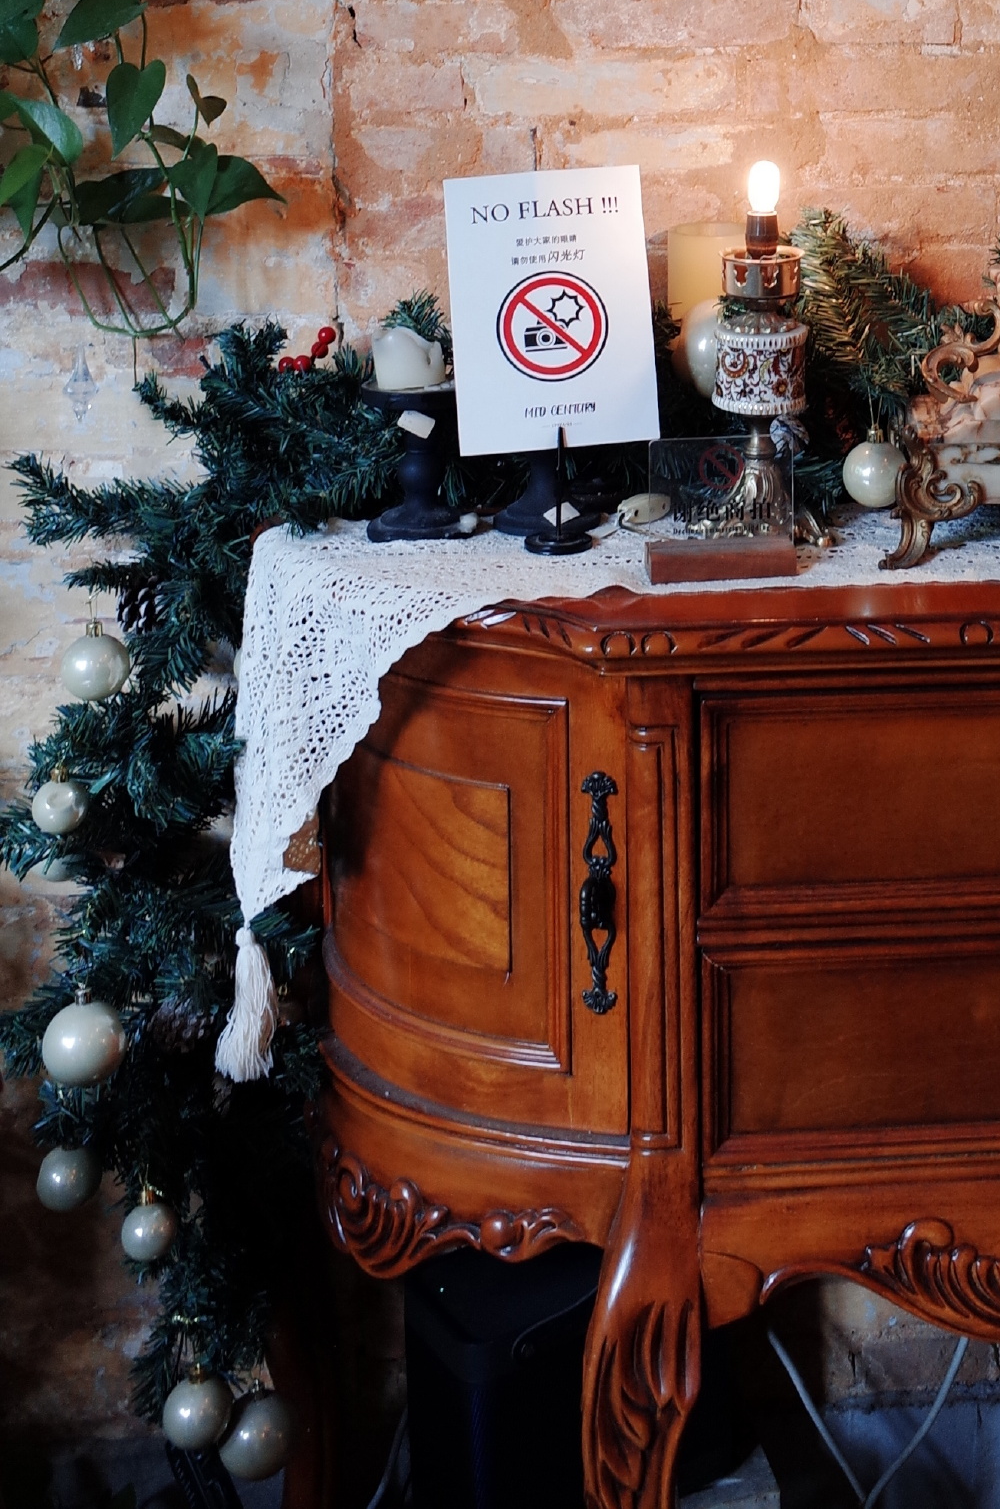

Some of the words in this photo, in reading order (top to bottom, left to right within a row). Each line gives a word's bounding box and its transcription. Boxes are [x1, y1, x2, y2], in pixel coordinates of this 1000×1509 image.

[470, 203, 510, 225] NO
[518, 196, 595, 220] FLASH
[601, 196, 619, 214] !!!
[524, 405, 547, 419] MID
[550, 401, 596, 416] CENTURY
[673, 497, 771, 523] 谢绝商拍
